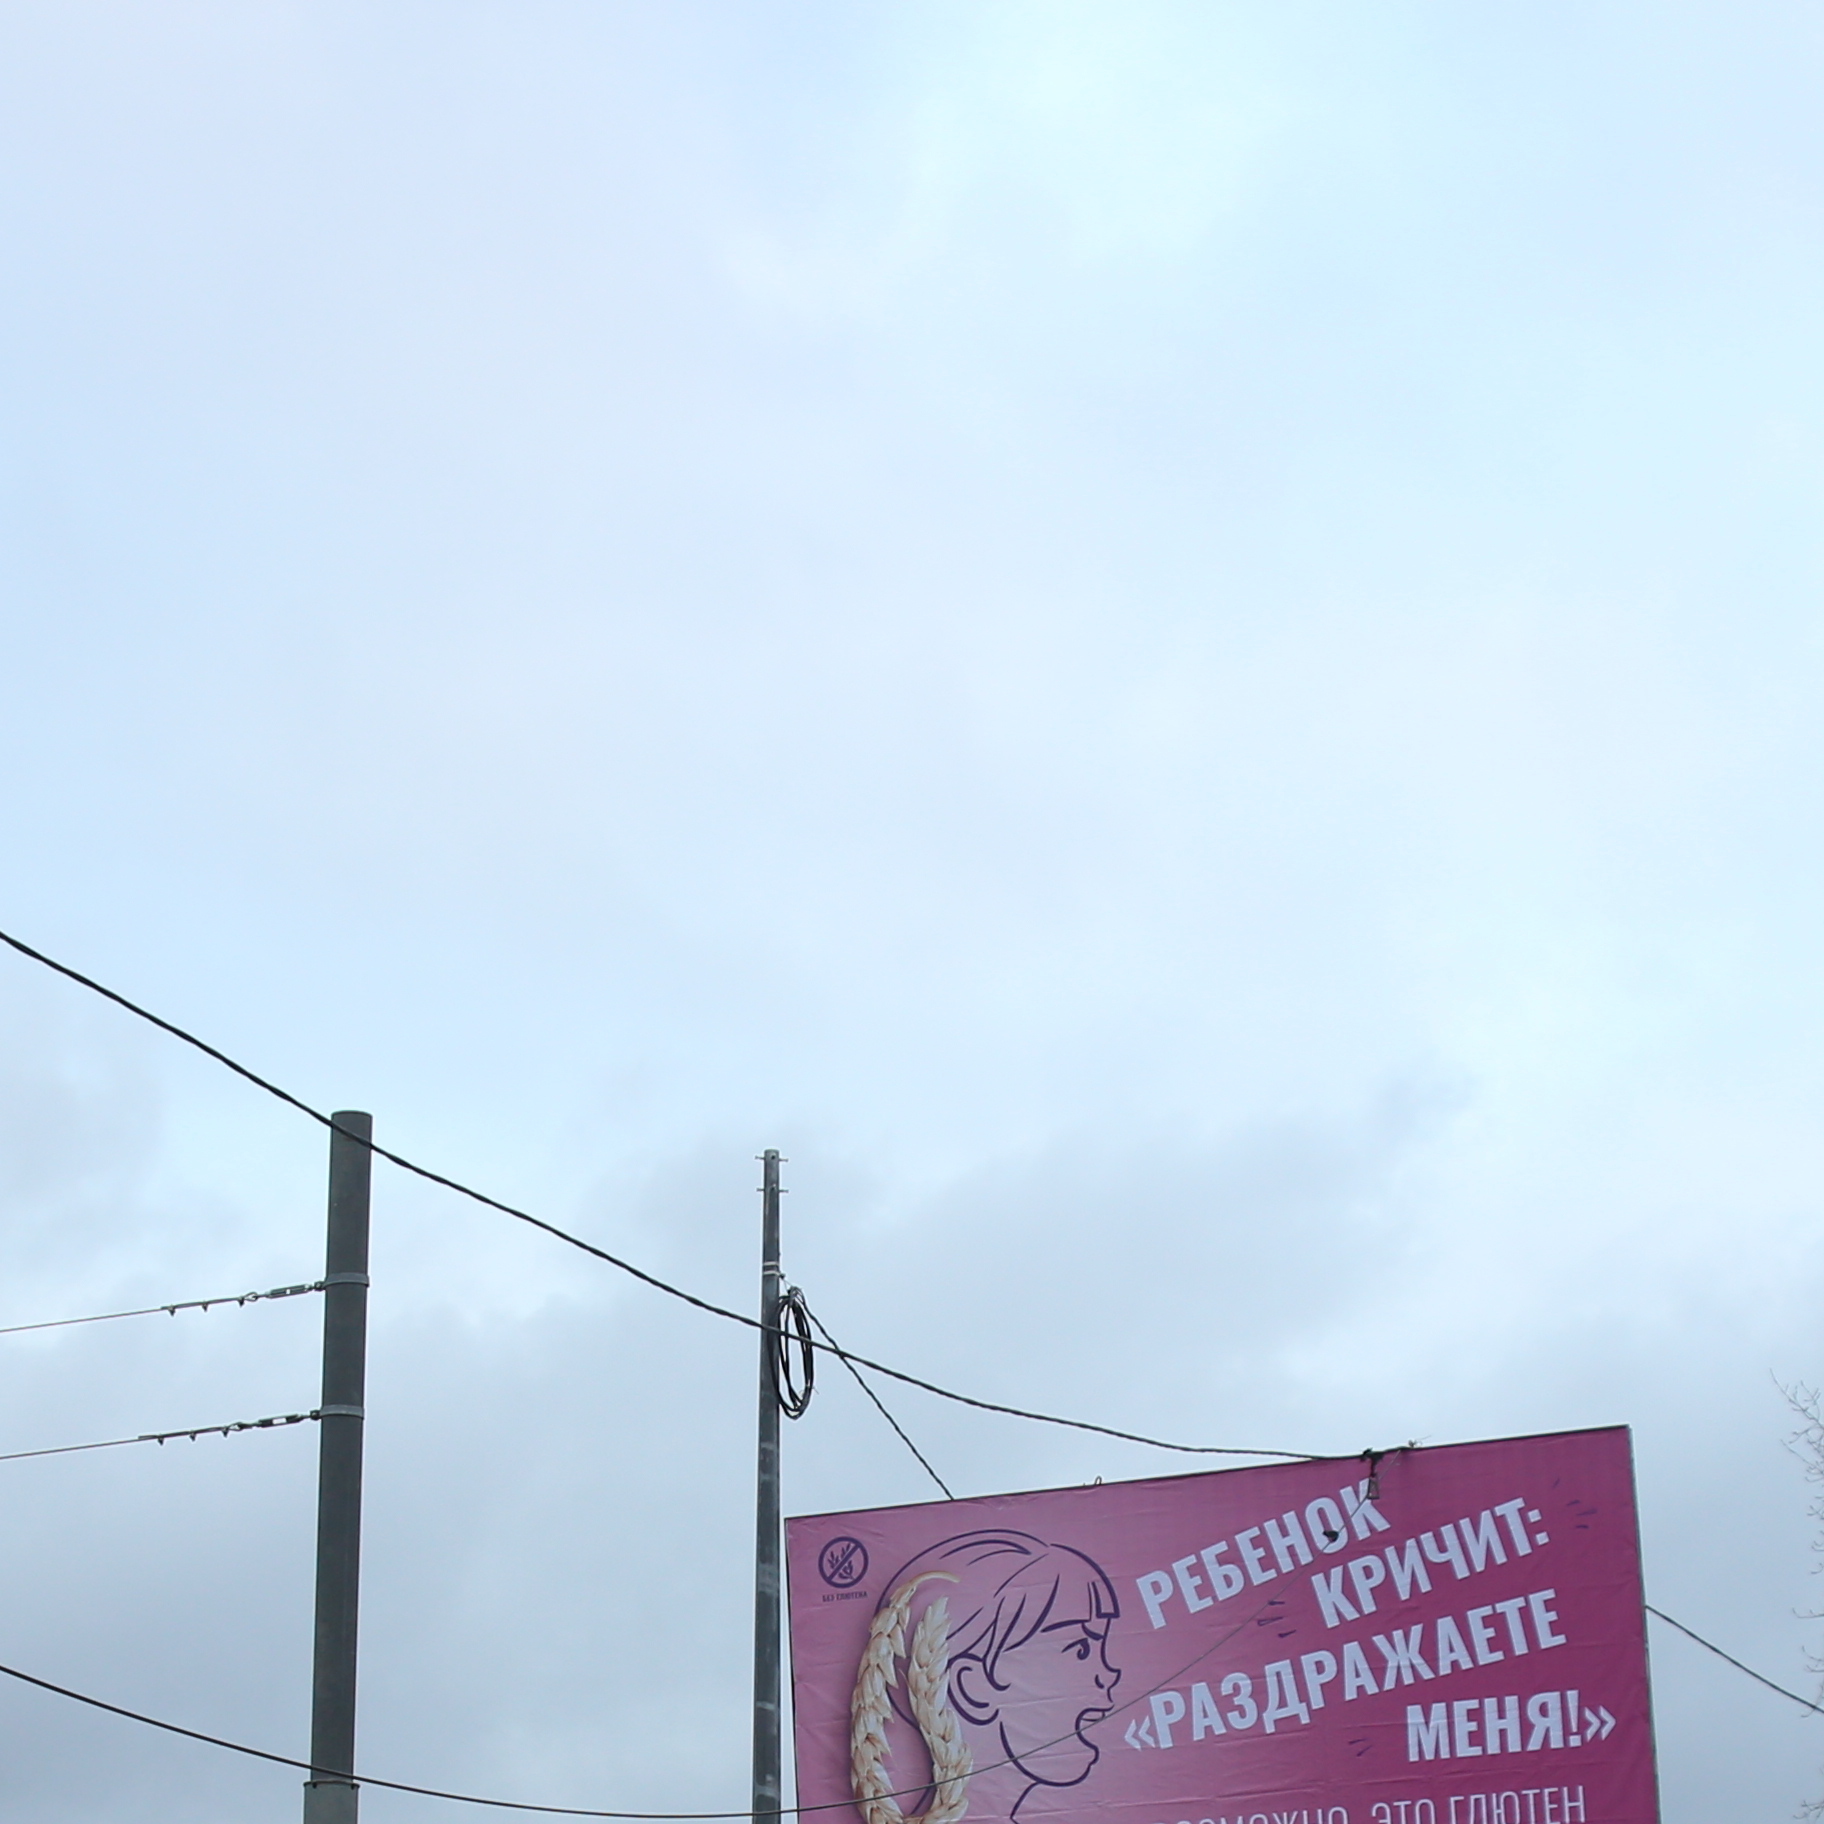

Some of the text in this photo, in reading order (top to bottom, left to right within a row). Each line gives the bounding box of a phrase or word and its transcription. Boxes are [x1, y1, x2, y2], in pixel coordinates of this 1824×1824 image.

[1136, 1477, 1391, 1630] РЕБЕНОК
[1310, 1497, 1550, 1629] КРИЧИТ:
[1124, 1588, 1567, 1752] «РАЗДРАЖАЕТЕ
[1405, 1689, 1617, 1763] МЕНЯ!»
